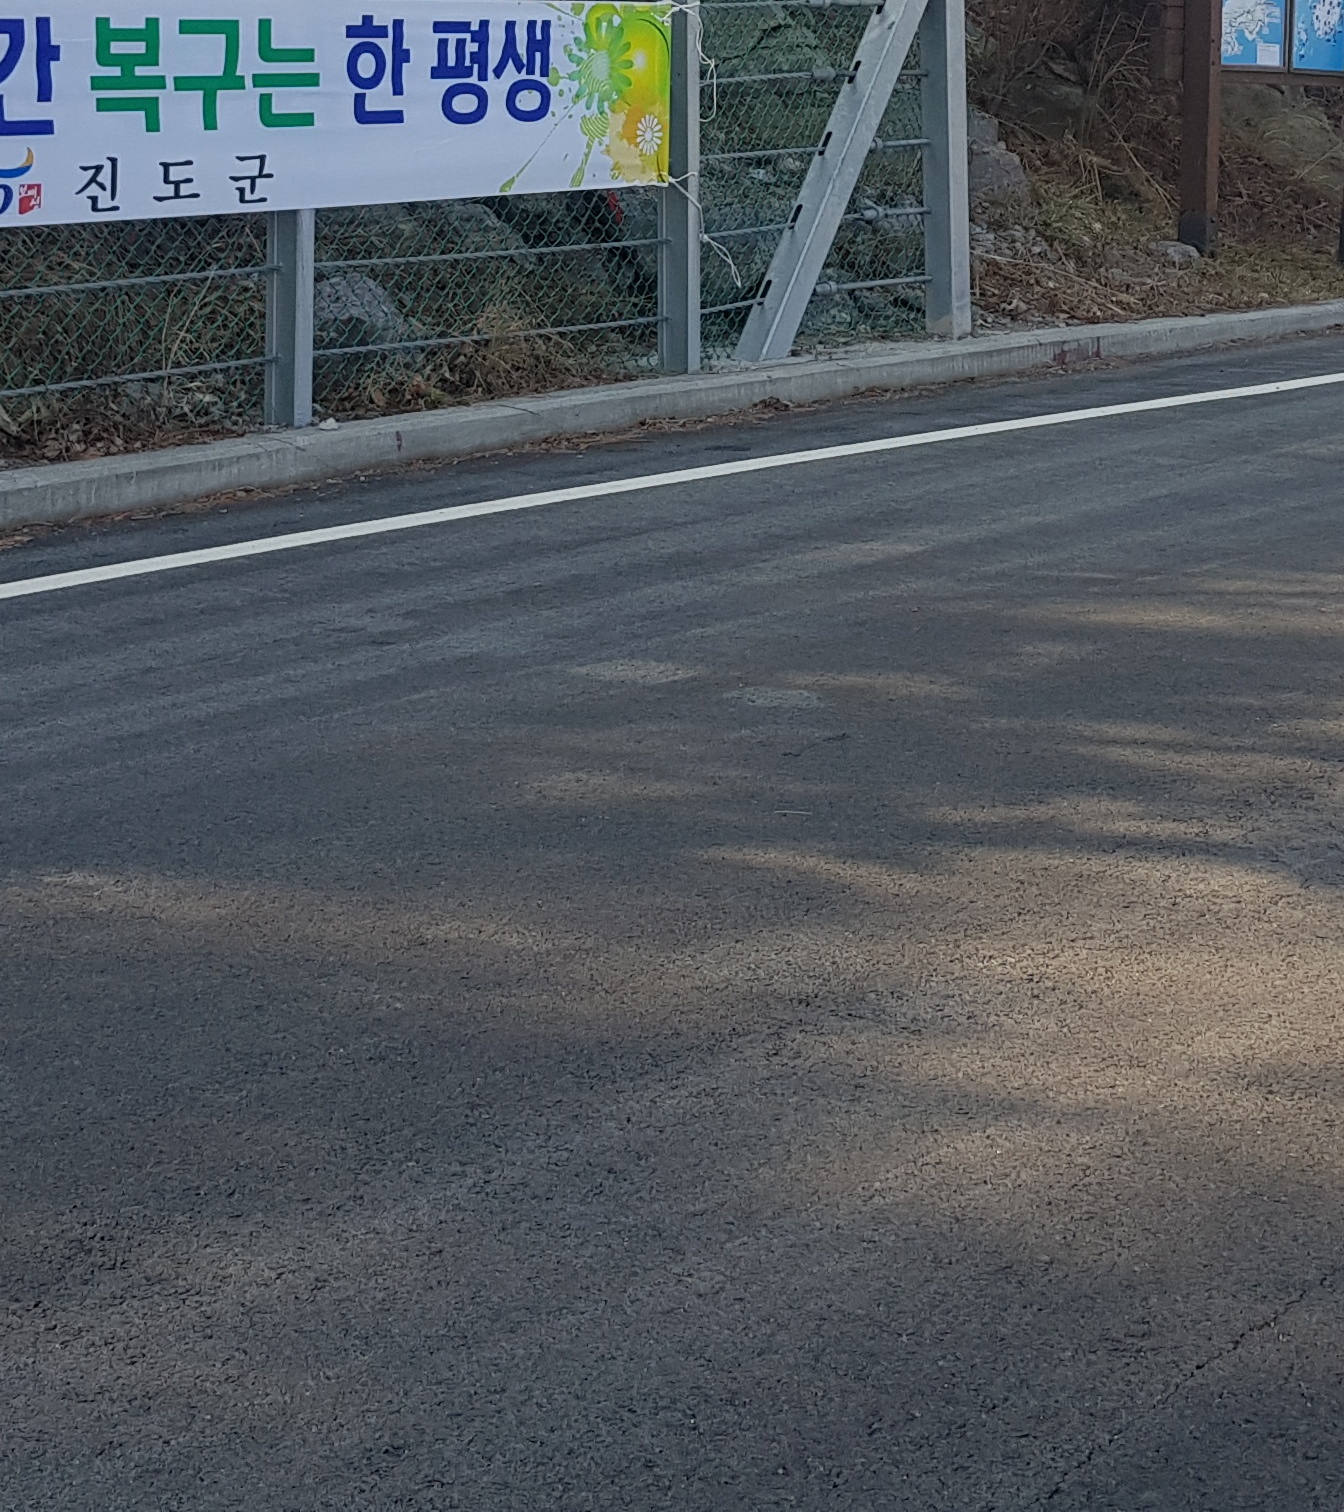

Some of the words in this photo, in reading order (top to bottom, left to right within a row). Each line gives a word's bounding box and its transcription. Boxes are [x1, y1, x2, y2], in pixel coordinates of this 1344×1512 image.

[89, 16, 321, 133] 복구는
[345, 14, 410, 125] 한
[429, 19, 552, 125] 평생
